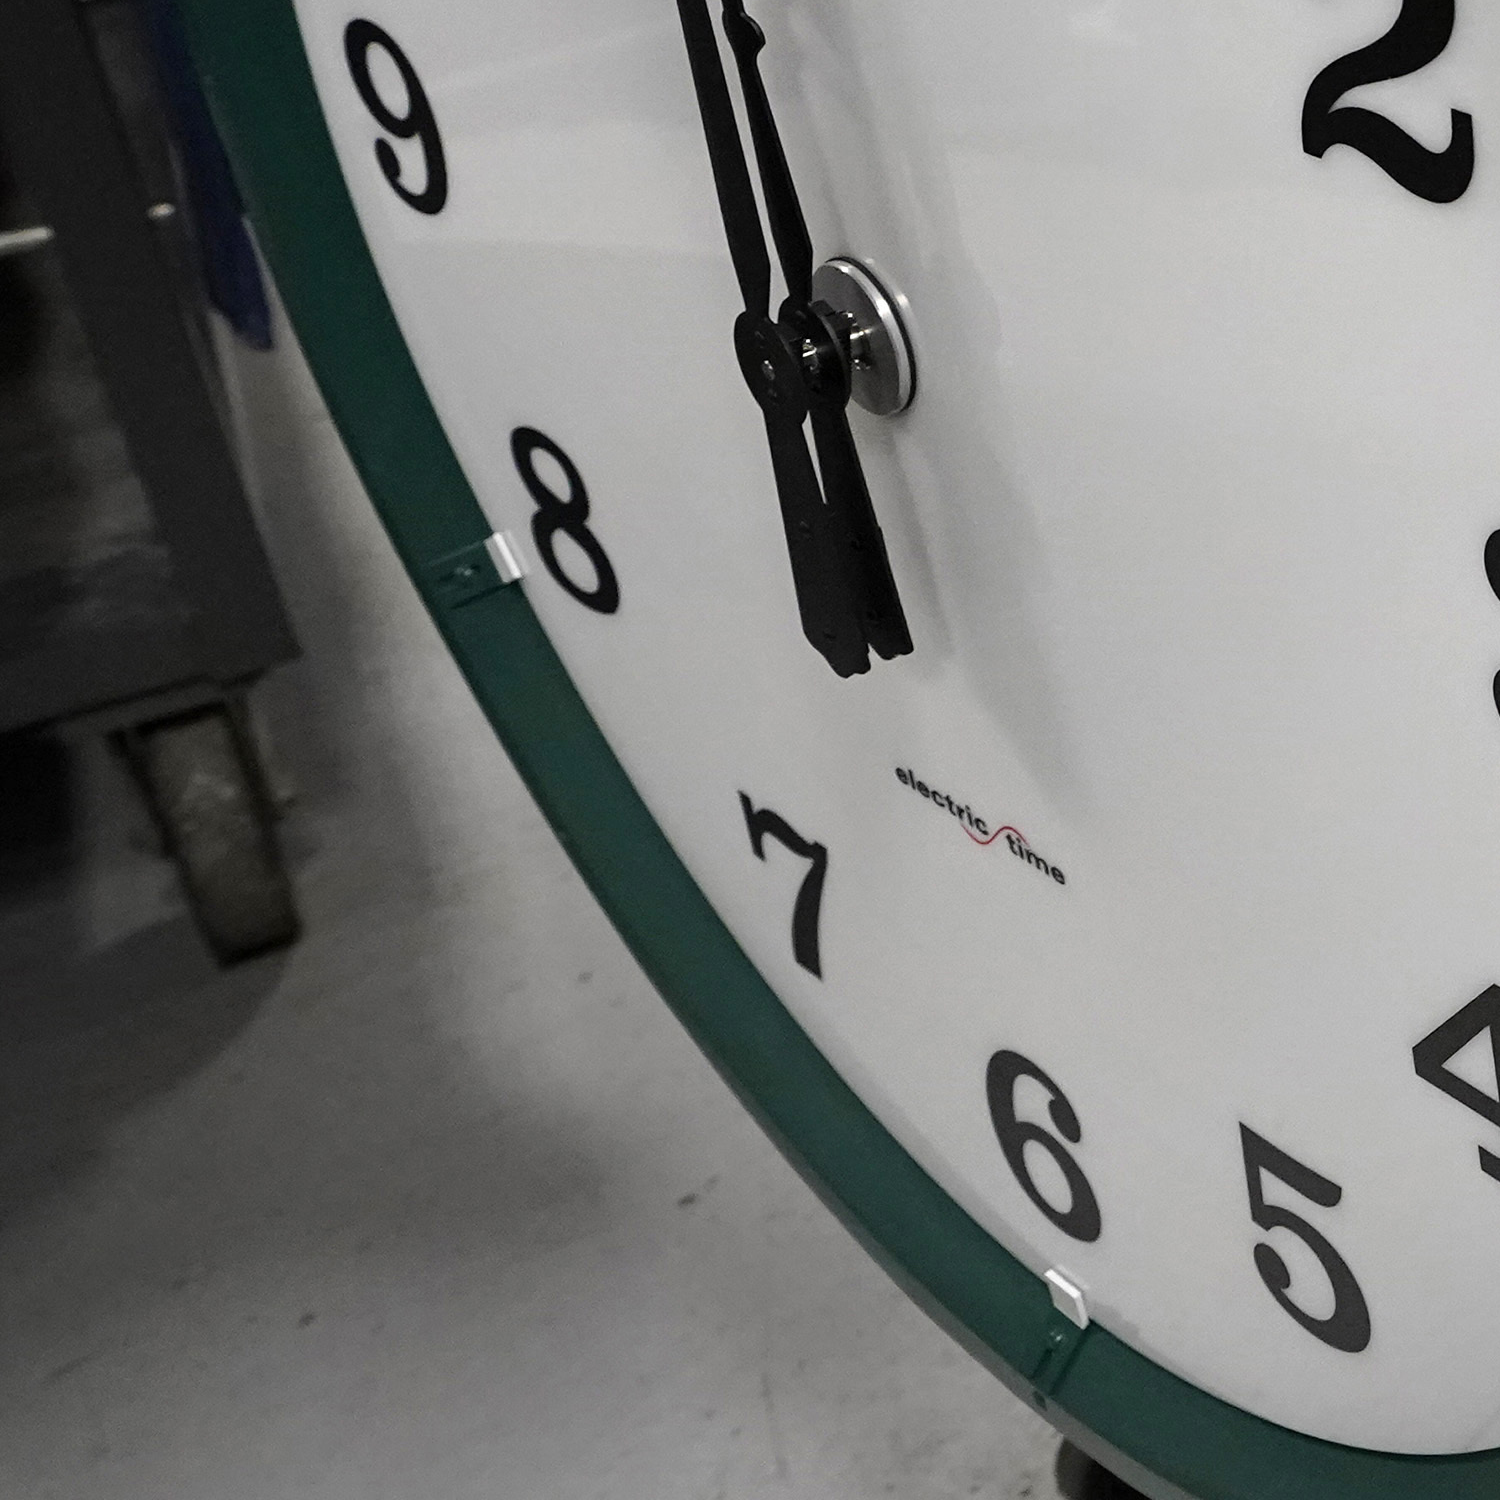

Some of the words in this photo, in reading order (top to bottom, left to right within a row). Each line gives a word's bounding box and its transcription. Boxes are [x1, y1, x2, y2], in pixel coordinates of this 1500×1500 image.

[344, 18, 448, 215] 9
[510, 426, 620, 615] 8
[739, 791, 828, 980] 7
[894, 766, 989, 836] electric
[1005, 833, 1066, 885] time
[986, 1050, 1101, 1243] 6
[1239, 1121, 1371, 1353] 5
